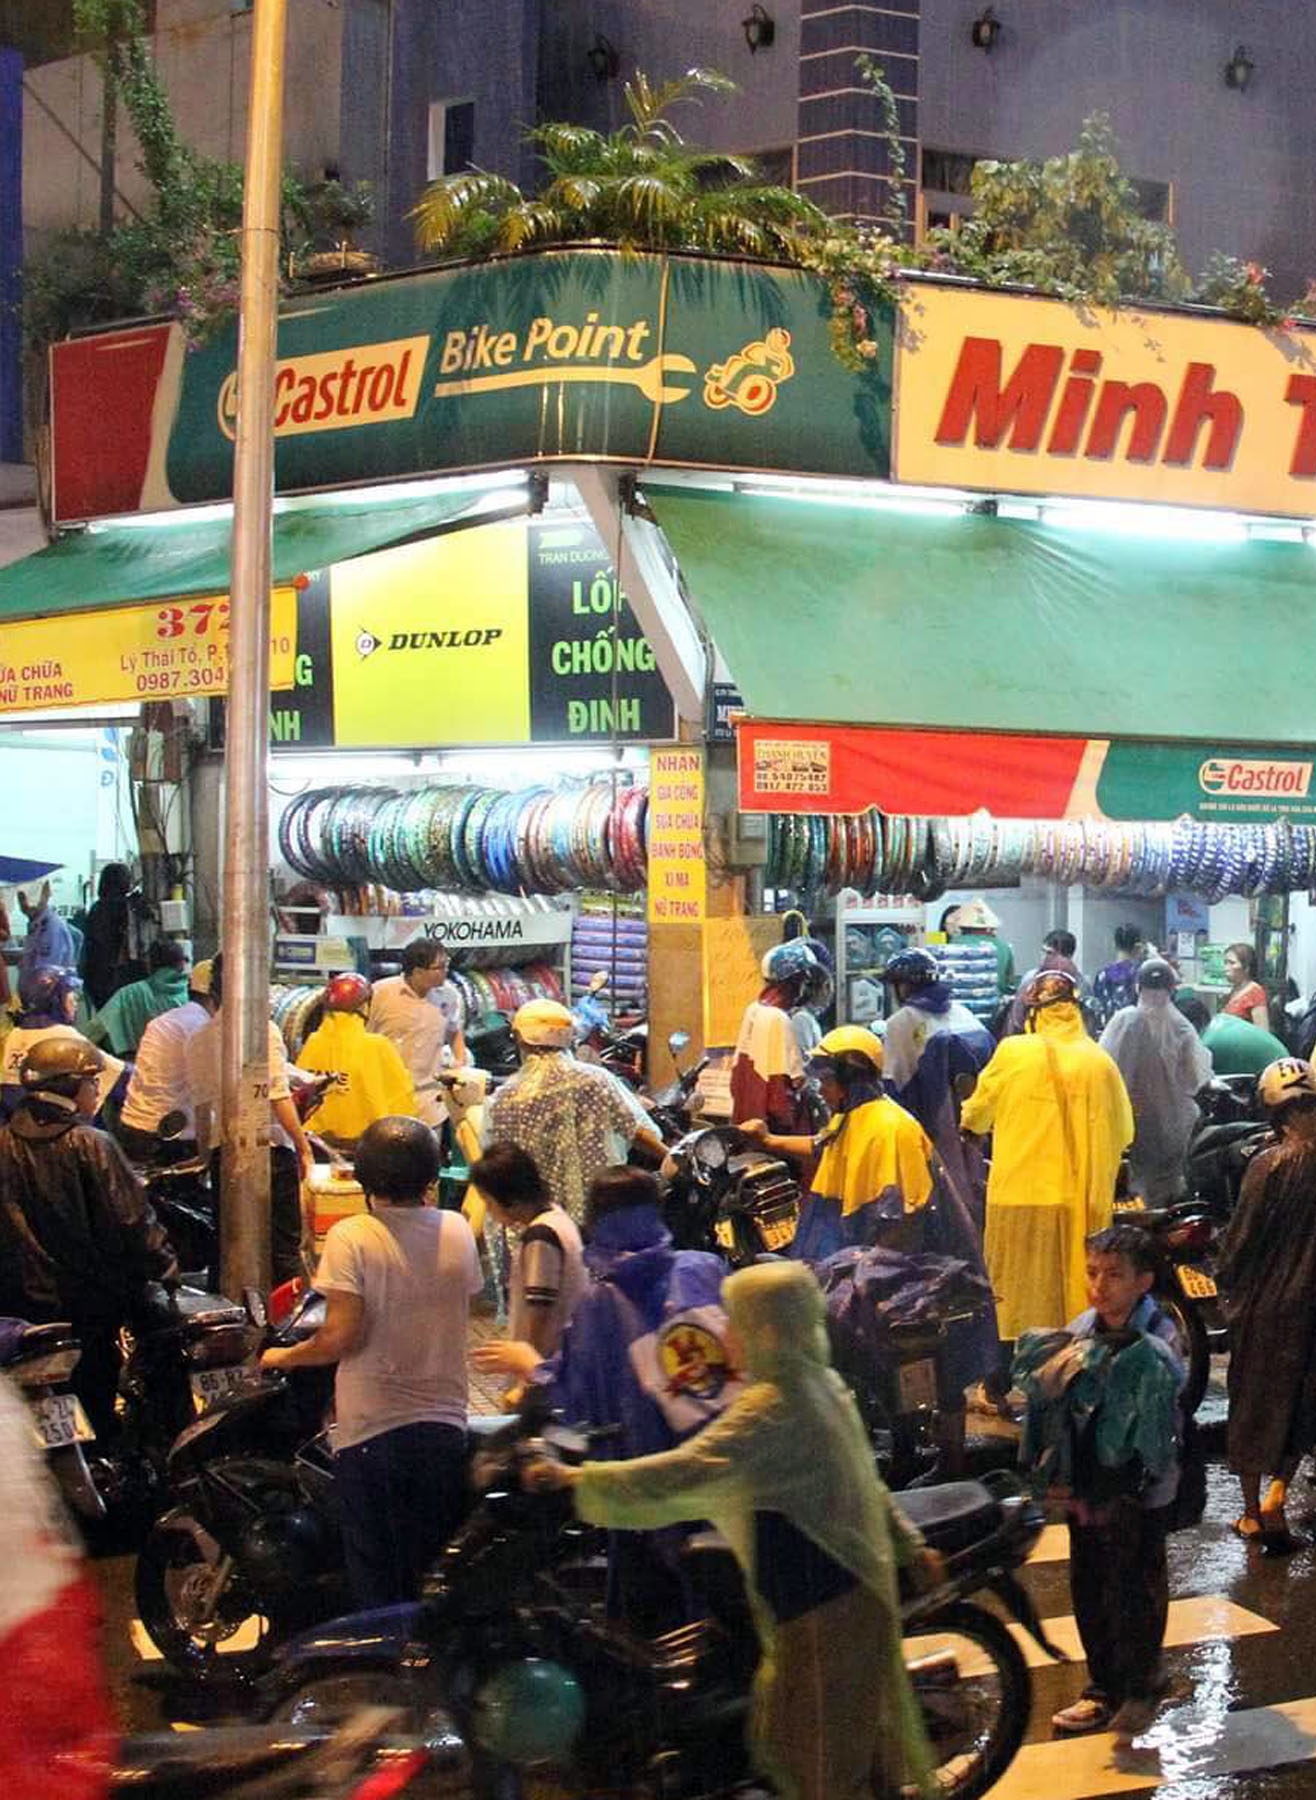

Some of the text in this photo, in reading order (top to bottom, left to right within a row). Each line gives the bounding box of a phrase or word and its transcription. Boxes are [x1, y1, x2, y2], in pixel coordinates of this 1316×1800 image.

[440, 313, 649, 374] Bike Point
[275, 350, 412, 427] Castrol
[934, 335, 1244, 471] Minh
[388, 628, 503, 651] DUNLOP
[552, 625, 657, 676] CHỐNG
[23, 682, 73, 702] TRANG
[568, 697, 640, 733] ĐINH
[1228, 764, 1304, 792] Castrol
[424, 920, 523, 940] YOKOHAMA
